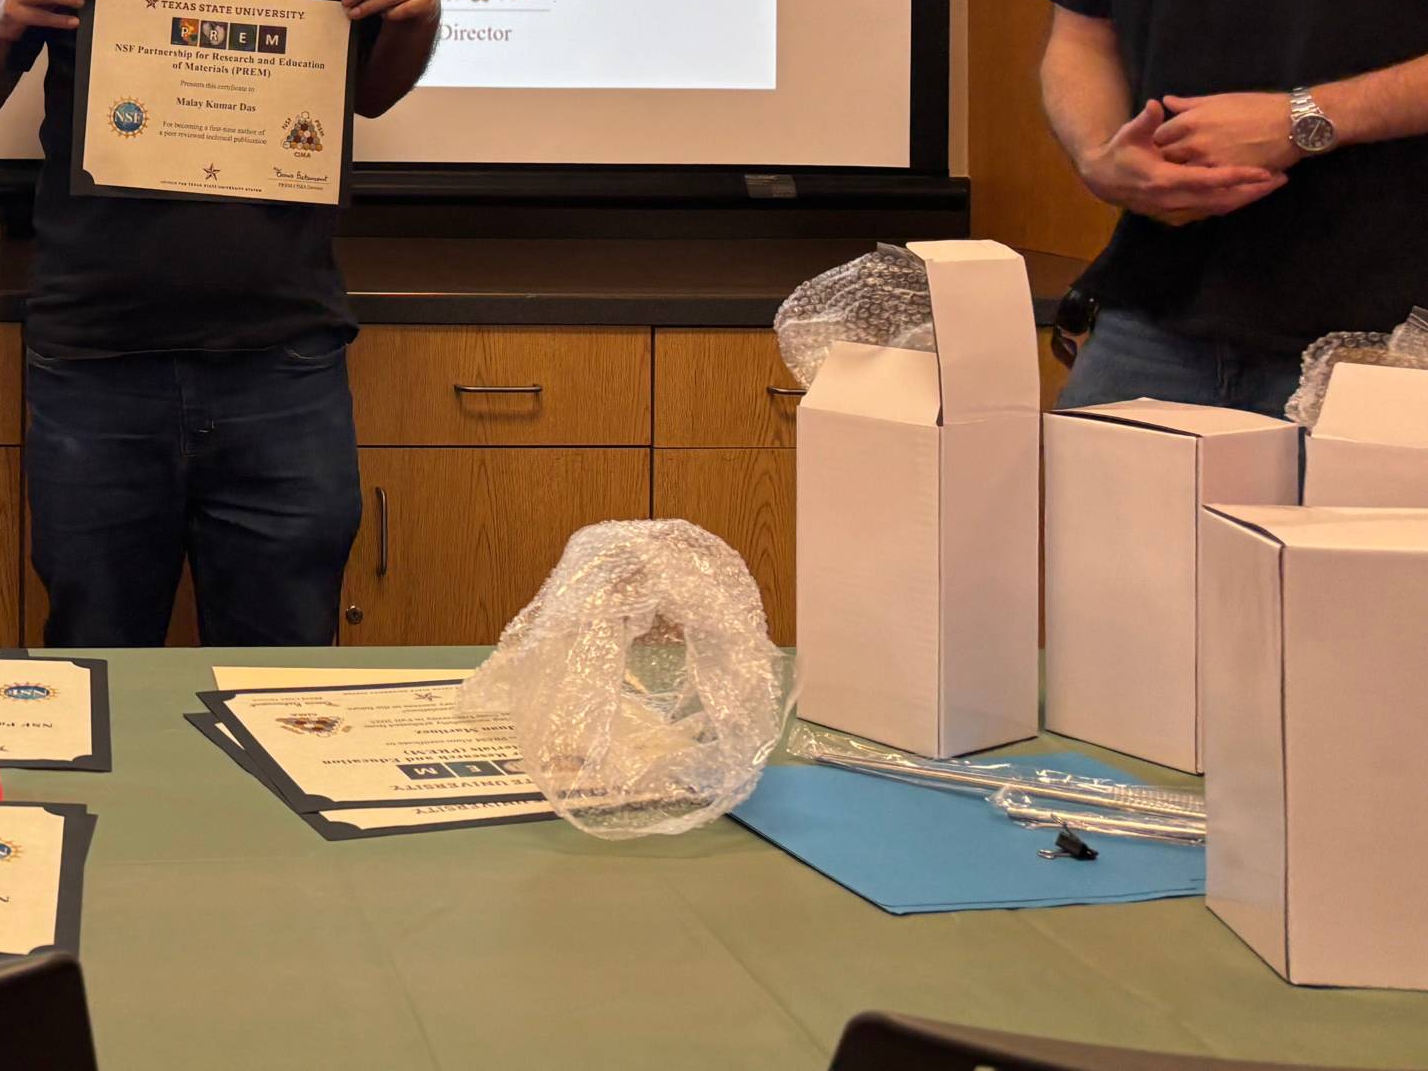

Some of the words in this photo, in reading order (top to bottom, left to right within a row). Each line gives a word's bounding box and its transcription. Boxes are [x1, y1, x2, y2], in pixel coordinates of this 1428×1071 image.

[161, 0, 197, 14] TEXAS
[199, 4, 233, 17] STATE
[235, 7, 306, 23] UNIVERSITY
[115, 43, 134, 53] NSF
[138, 46, 193, 60] Partnership
[195, 51, 209, 61] for
[212, 53, 254, 64] Research
[257, 57, 276, 66] and
[279, 58, 326, 70] Education
[172, 62, 183, 70] of
[185, 63, 230, 75] Materials
[231, 67, 272, 79] (PREM)
[177, 97, 204, 110] Malay
[205, 100, 237, 111] Kumar
[239, 103, 257, 113] Das
[114, 110, 143, 124] NSF
[390, 780, 508, 791] UNIVERSITY
